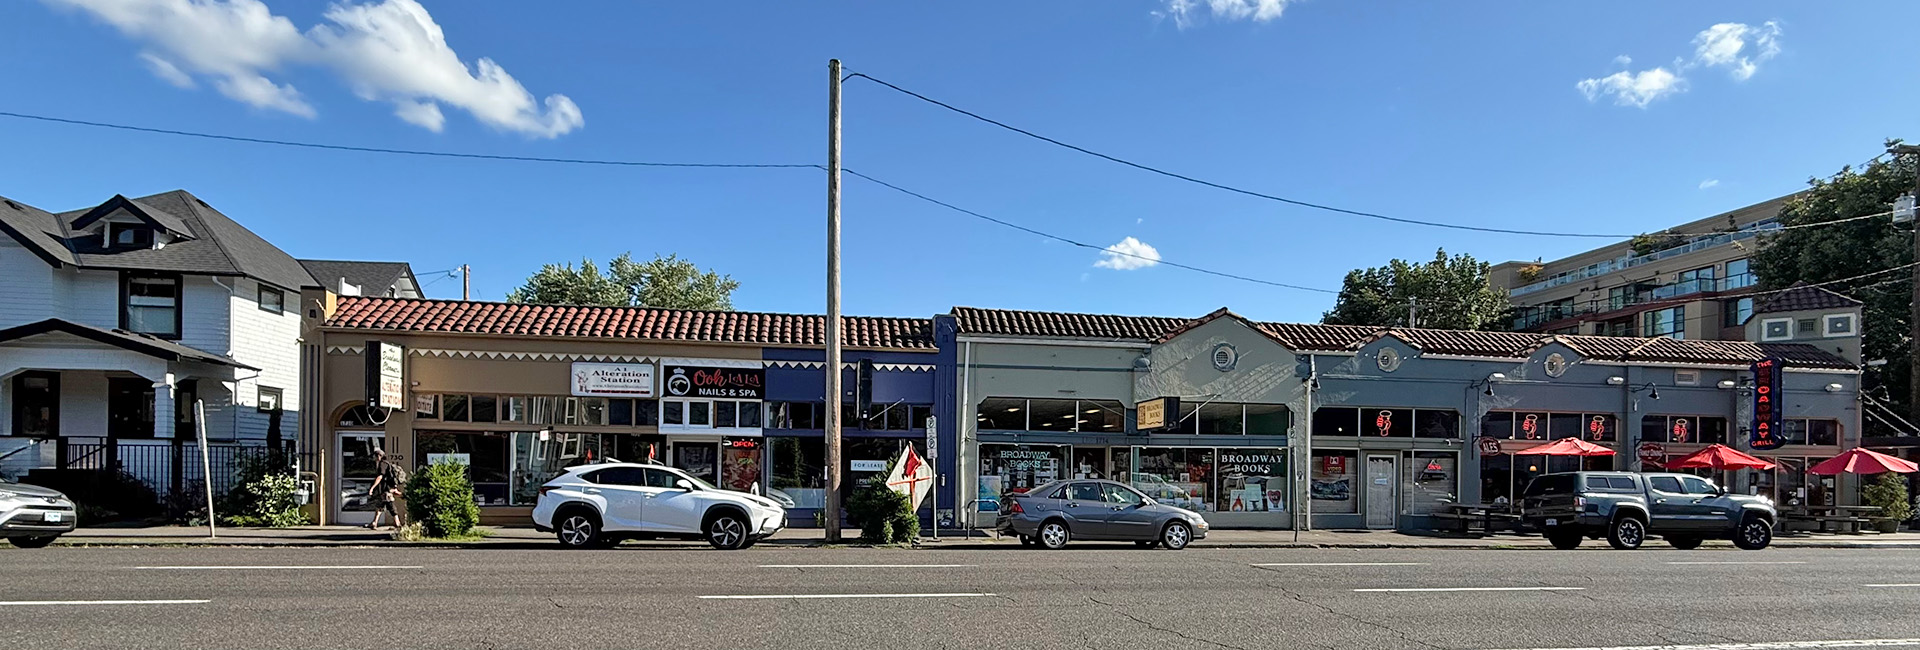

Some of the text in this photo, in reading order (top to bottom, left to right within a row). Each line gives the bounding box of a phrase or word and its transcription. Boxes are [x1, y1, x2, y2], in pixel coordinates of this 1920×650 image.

[1757, 360, 1772, 368] THE
[592, 370, 650, 378] Alteration
[693, 369, 727, 387] Ooh
[699, 388, 757, 397] NAILS & SPA
[1000, 450, 1051, 460] BROADWAY
[1221, 455, 1284, 463] BROADWAY
[1010, 459, 1041, 468] BOOKS
[1234, 464, 1271, 473] BOOKS
